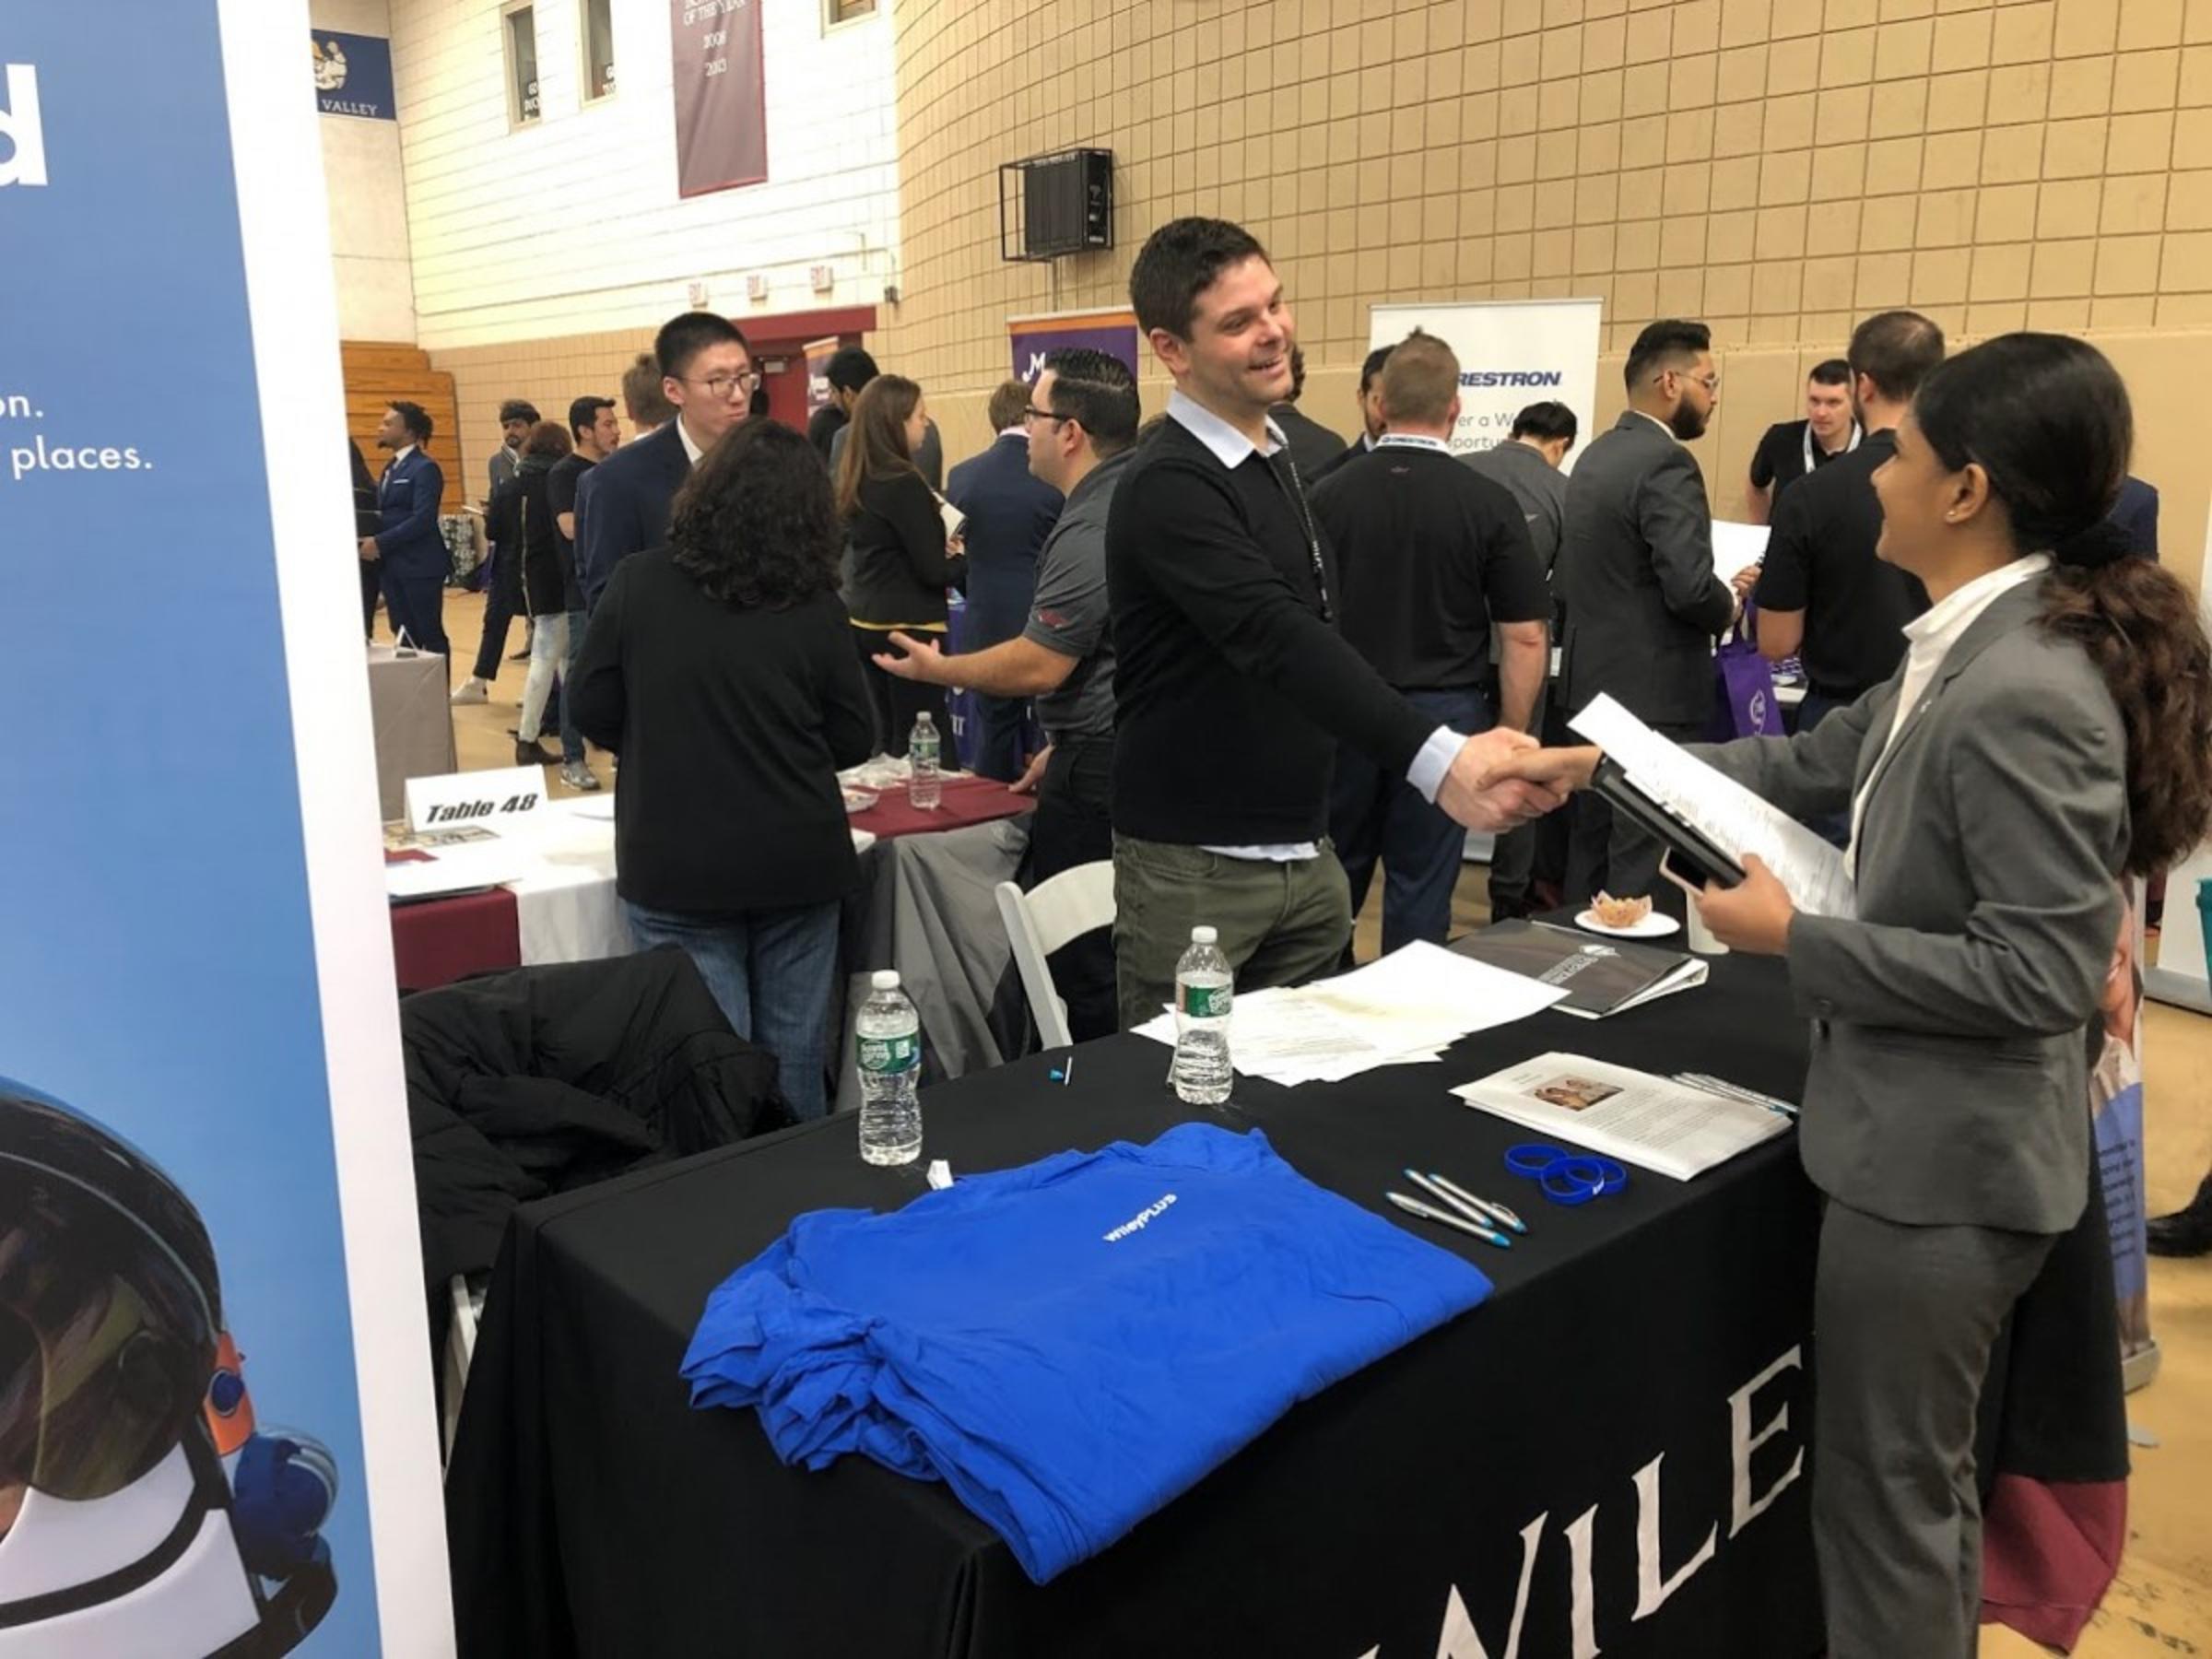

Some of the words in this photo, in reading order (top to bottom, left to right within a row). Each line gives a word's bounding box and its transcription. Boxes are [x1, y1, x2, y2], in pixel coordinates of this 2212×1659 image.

[321, 99, 379, 116] VALLEY
[1458, 371, 1561, 387] RESTRON
[11, 434, 152, 480] places.
[426, 799, 495, 824] Table
[500, 793, 537, 814] 48
[1356, 1344, 1804, 1659] ILE
